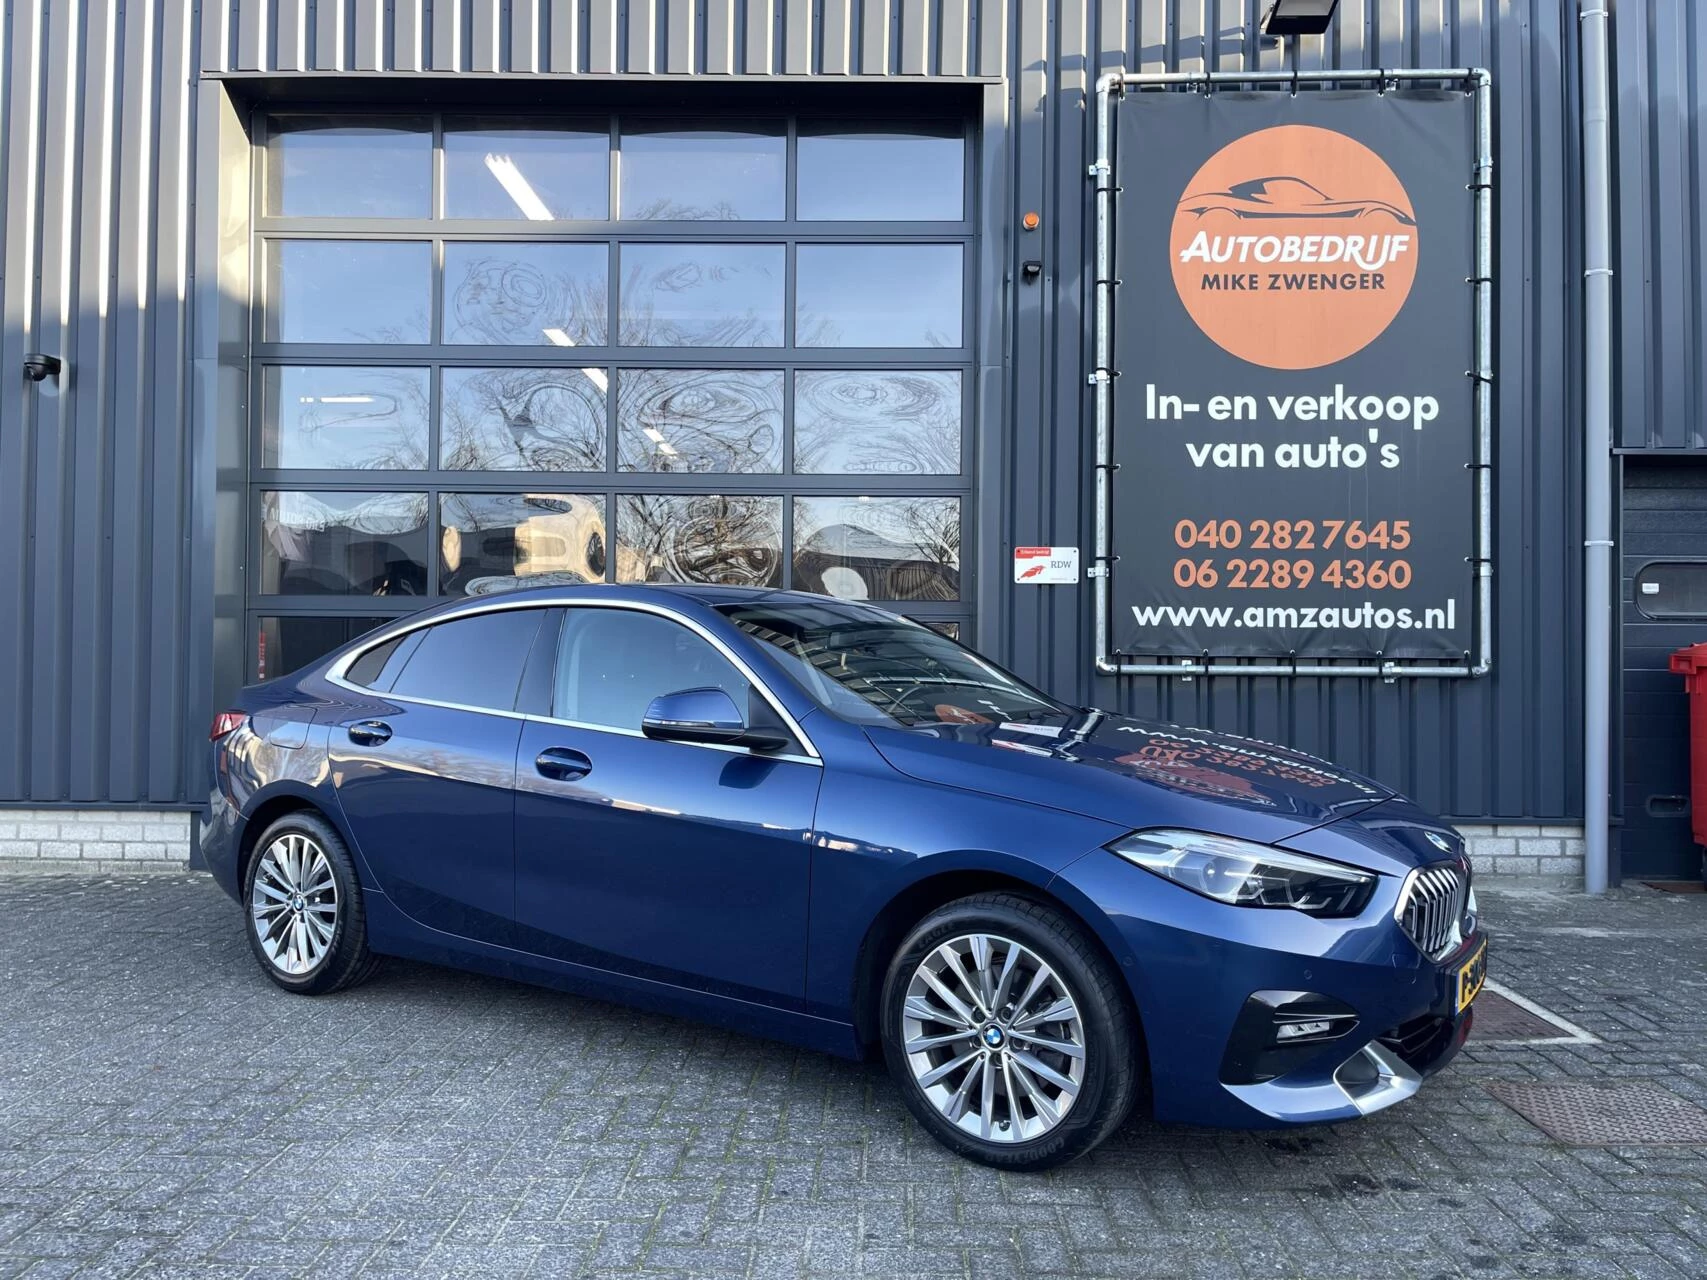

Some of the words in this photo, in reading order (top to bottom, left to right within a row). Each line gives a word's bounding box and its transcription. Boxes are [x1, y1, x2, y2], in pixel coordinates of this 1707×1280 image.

[1201, 274, 1259, 290] MIKE
[1268, 273, 1386, 290] ZWENGER
[1146, 384, 1200, 420] In-
[1207, 395, 1257, 420] en
[1267, 384, 1439, 429] verkoop
[1186, 442, 1265, 468] van
[1274, 428, 1400, 468] auto's
[1174, 520, 1242, 549] 040
[1249, 520, 1316, 549] 282
[1321, 520, 1410, 549] 7645
[1051, 561, 1072, 569] RDW
[1174, 559, 1218, 588] 06
[1227, 559, 1315, 588] 2289
[1321, 559, 1411, 588] 4360
[1131, 599, 1455, 631] www.amzautos.nl
